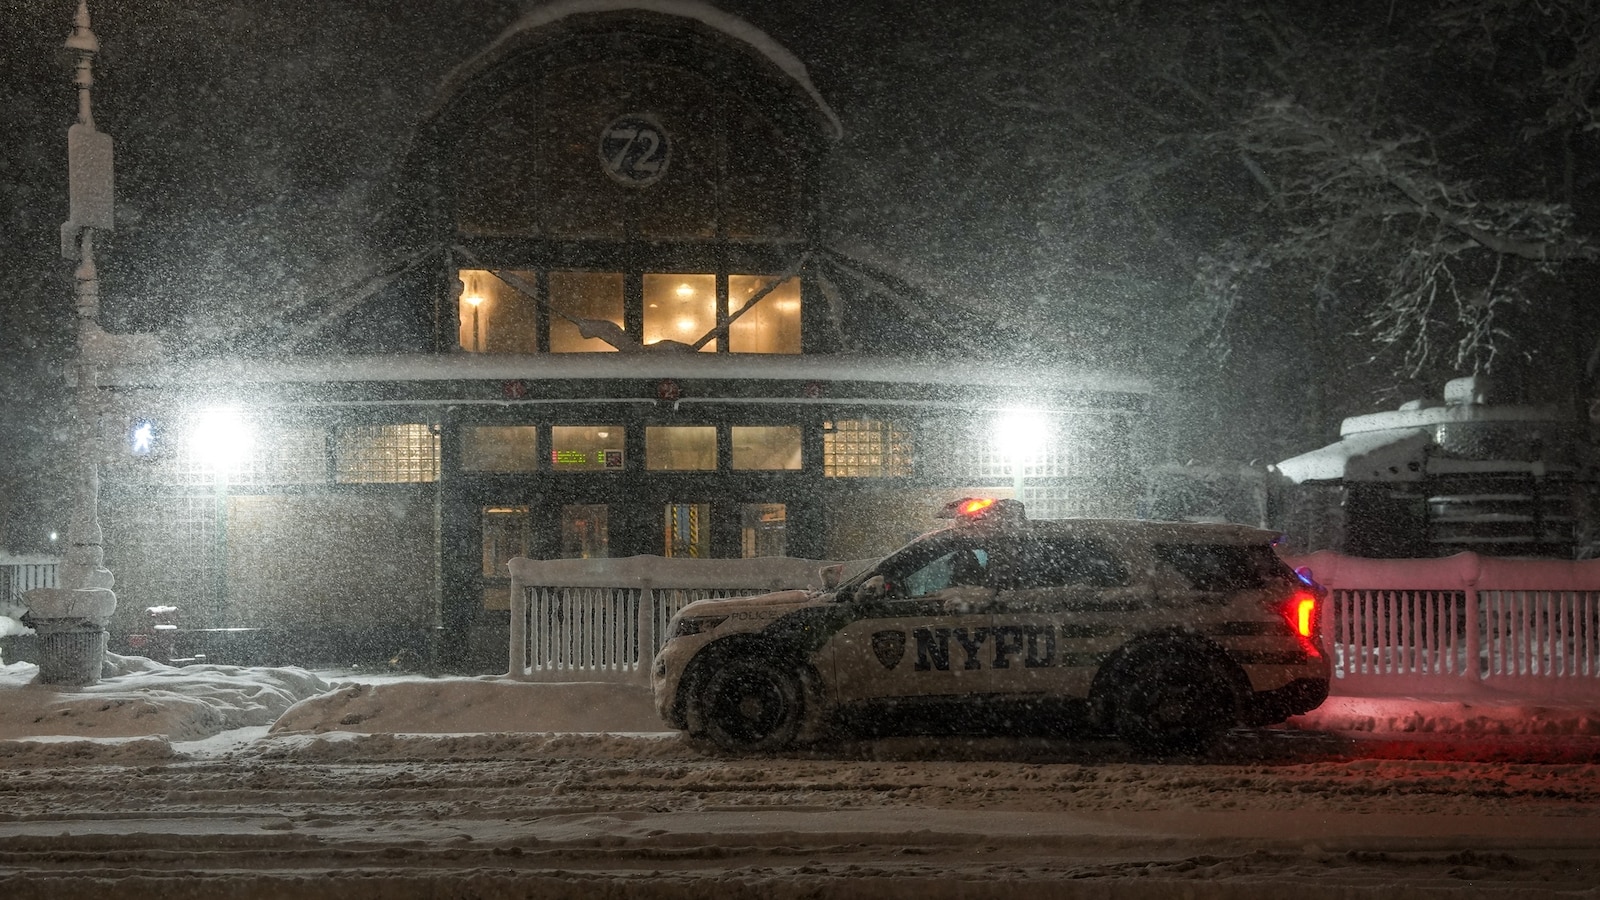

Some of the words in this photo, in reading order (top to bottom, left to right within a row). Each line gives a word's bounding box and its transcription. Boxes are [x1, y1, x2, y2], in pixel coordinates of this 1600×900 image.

[608, 128, 660, 172] 72
[731, 610, 777, 621] POLICE
[913, 626, 1056, 671] NYPD
